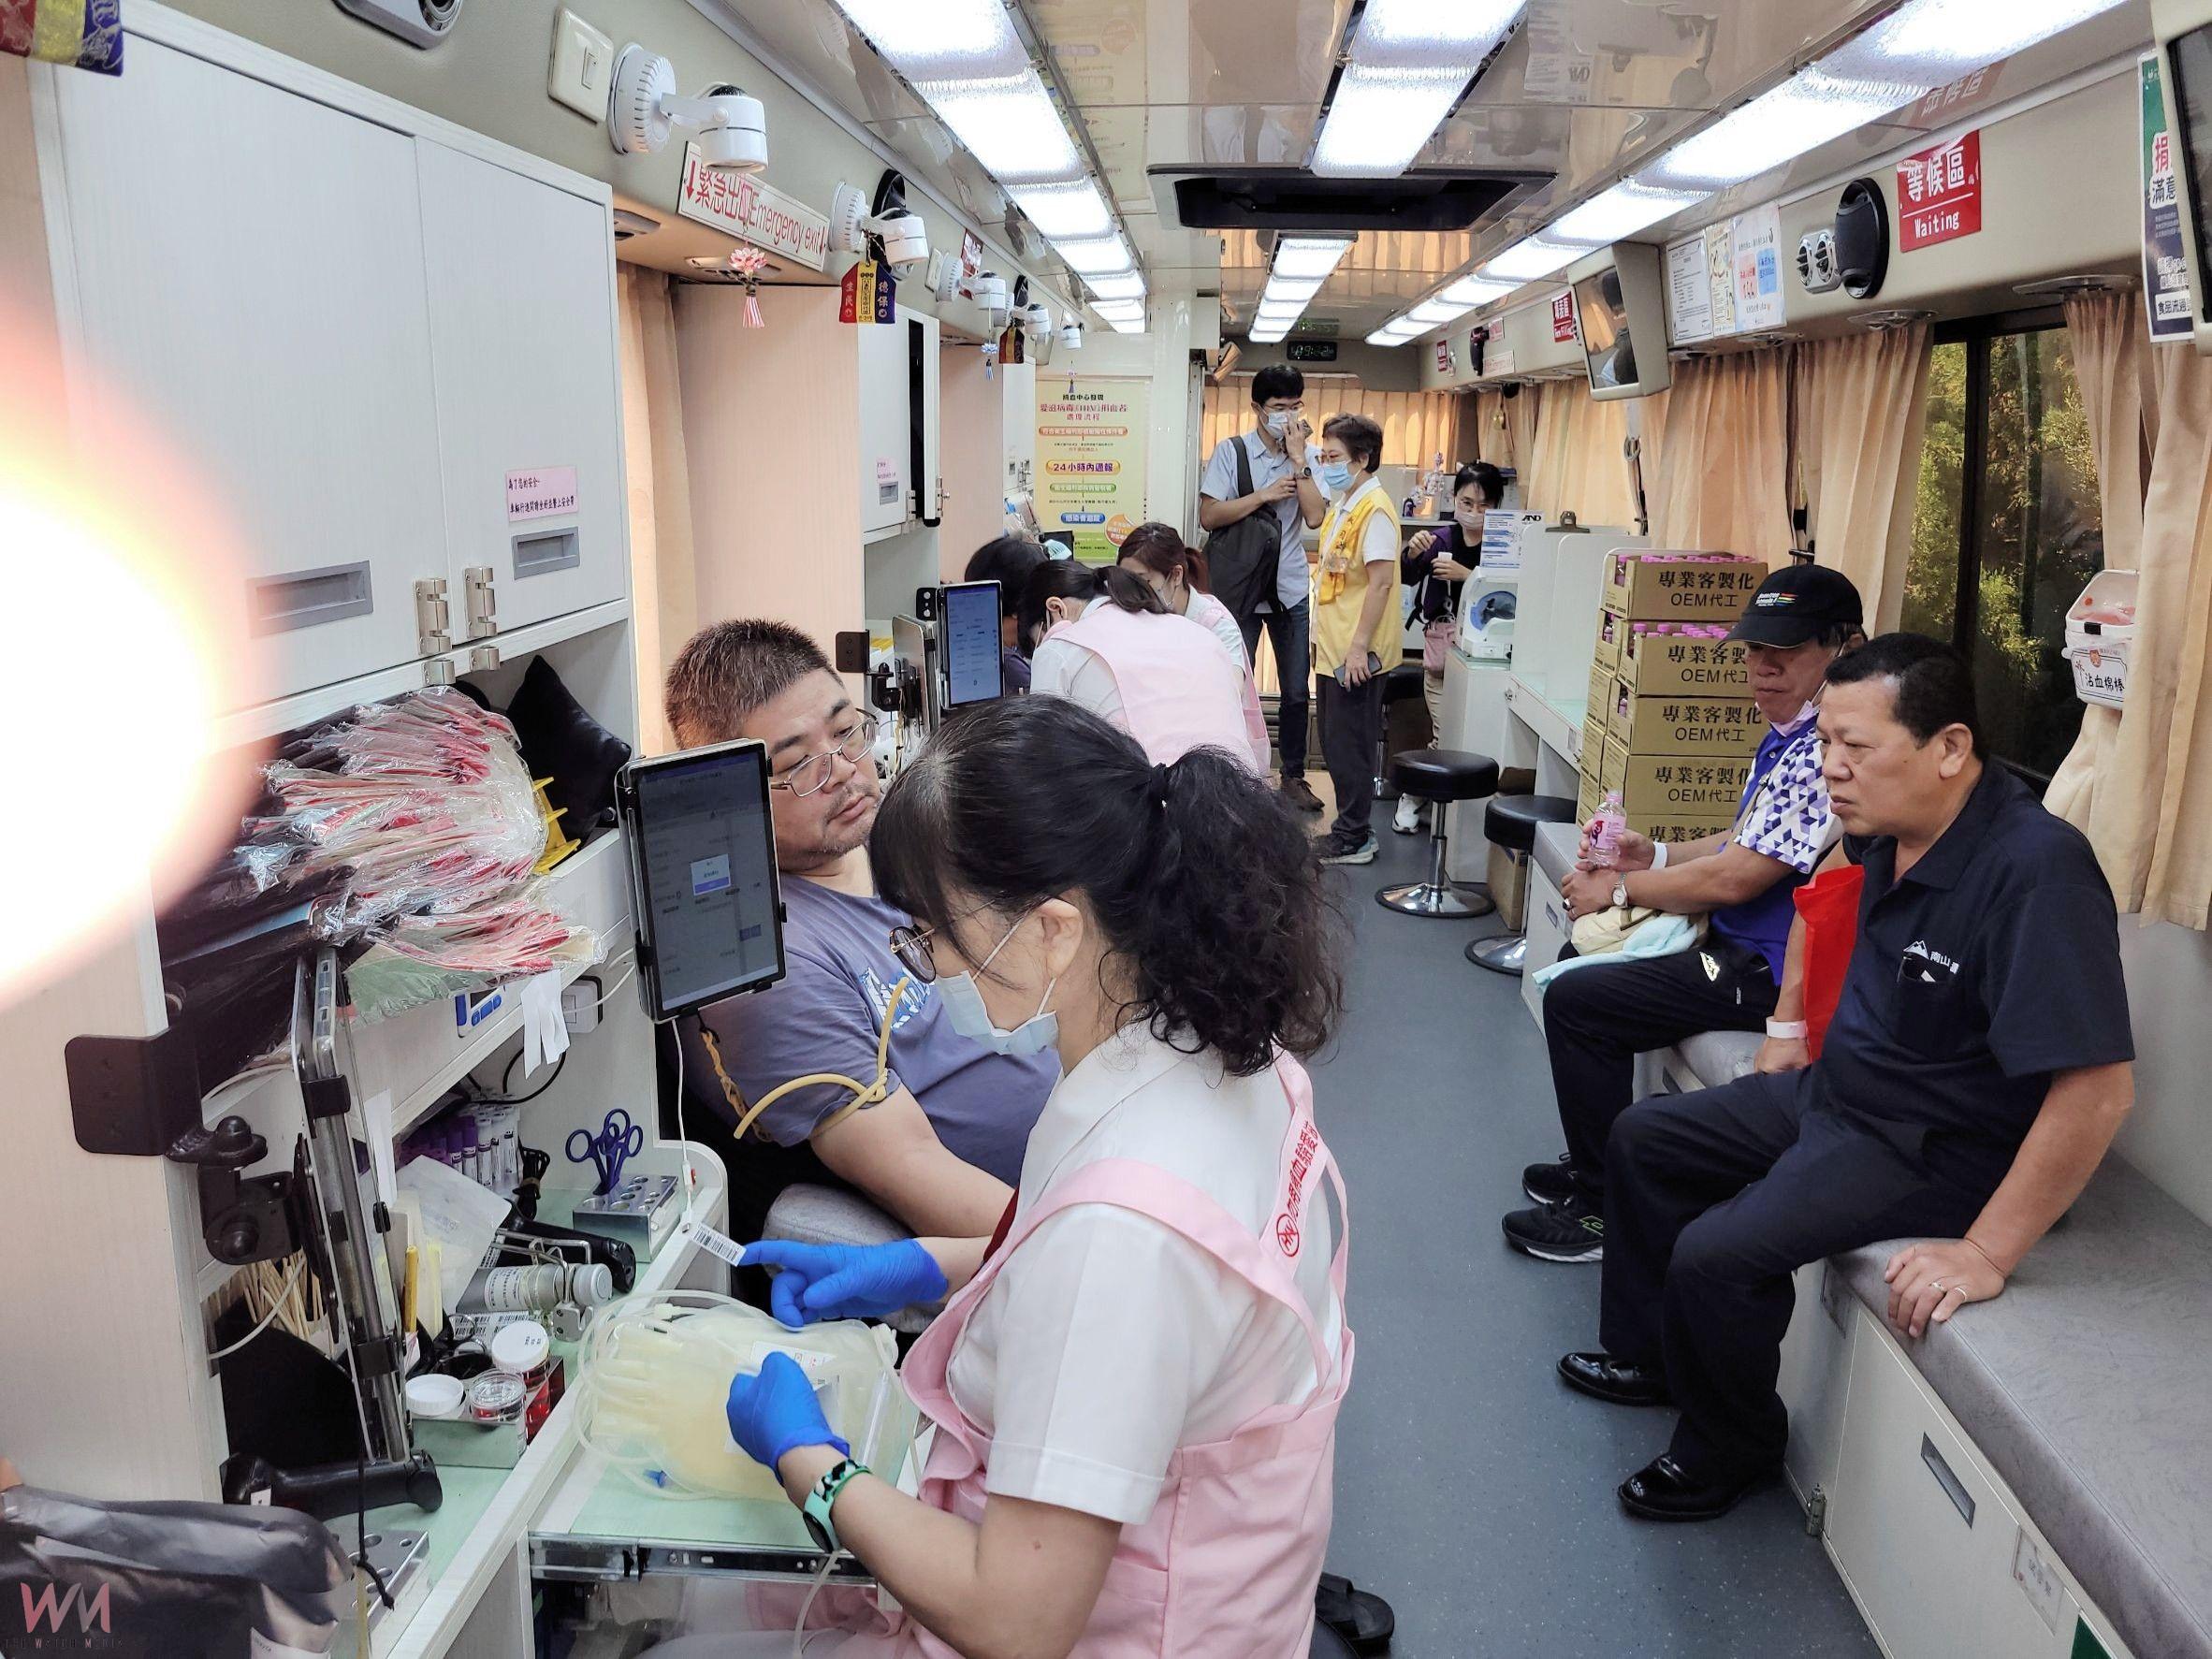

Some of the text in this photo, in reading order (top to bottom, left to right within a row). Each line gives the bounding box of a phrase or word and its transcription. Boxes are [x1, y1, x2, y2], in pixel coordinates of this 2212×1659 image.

[1907, 145, 1966, 203] 等候區
[749, 193, 806, 253] Emergency
[805, 224, 821, 254] exit
[1914, 211, 1960, 239] Waiting
[1658, 571, 1754, 590] 專業客製化
[2085, 673, 2125, 693] 沾血棉棒
[1662, 706, 1762, 725] 專業客製化
